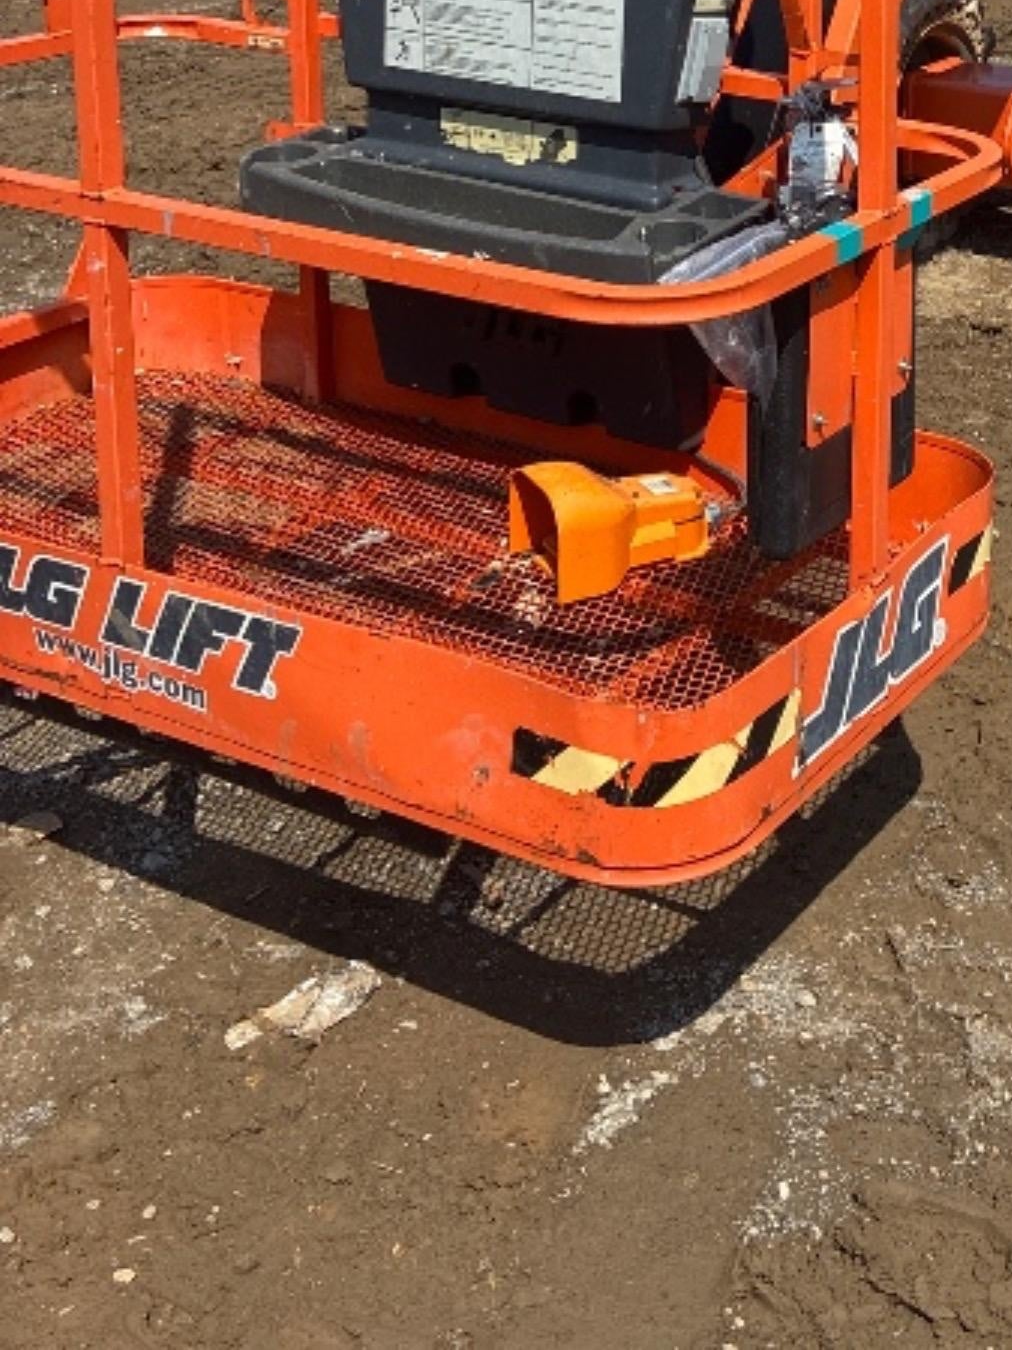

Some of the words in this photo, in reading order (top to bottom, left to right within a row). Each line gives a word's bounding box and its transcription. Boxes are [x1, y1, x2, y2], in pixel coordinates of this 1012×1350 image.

[0, 542, 90, 630] LG
[99, 575, 304, 697] LIFT
[33, 627, 208, 712] www.jlg.com
[800, 534, 950, 772] JLG
